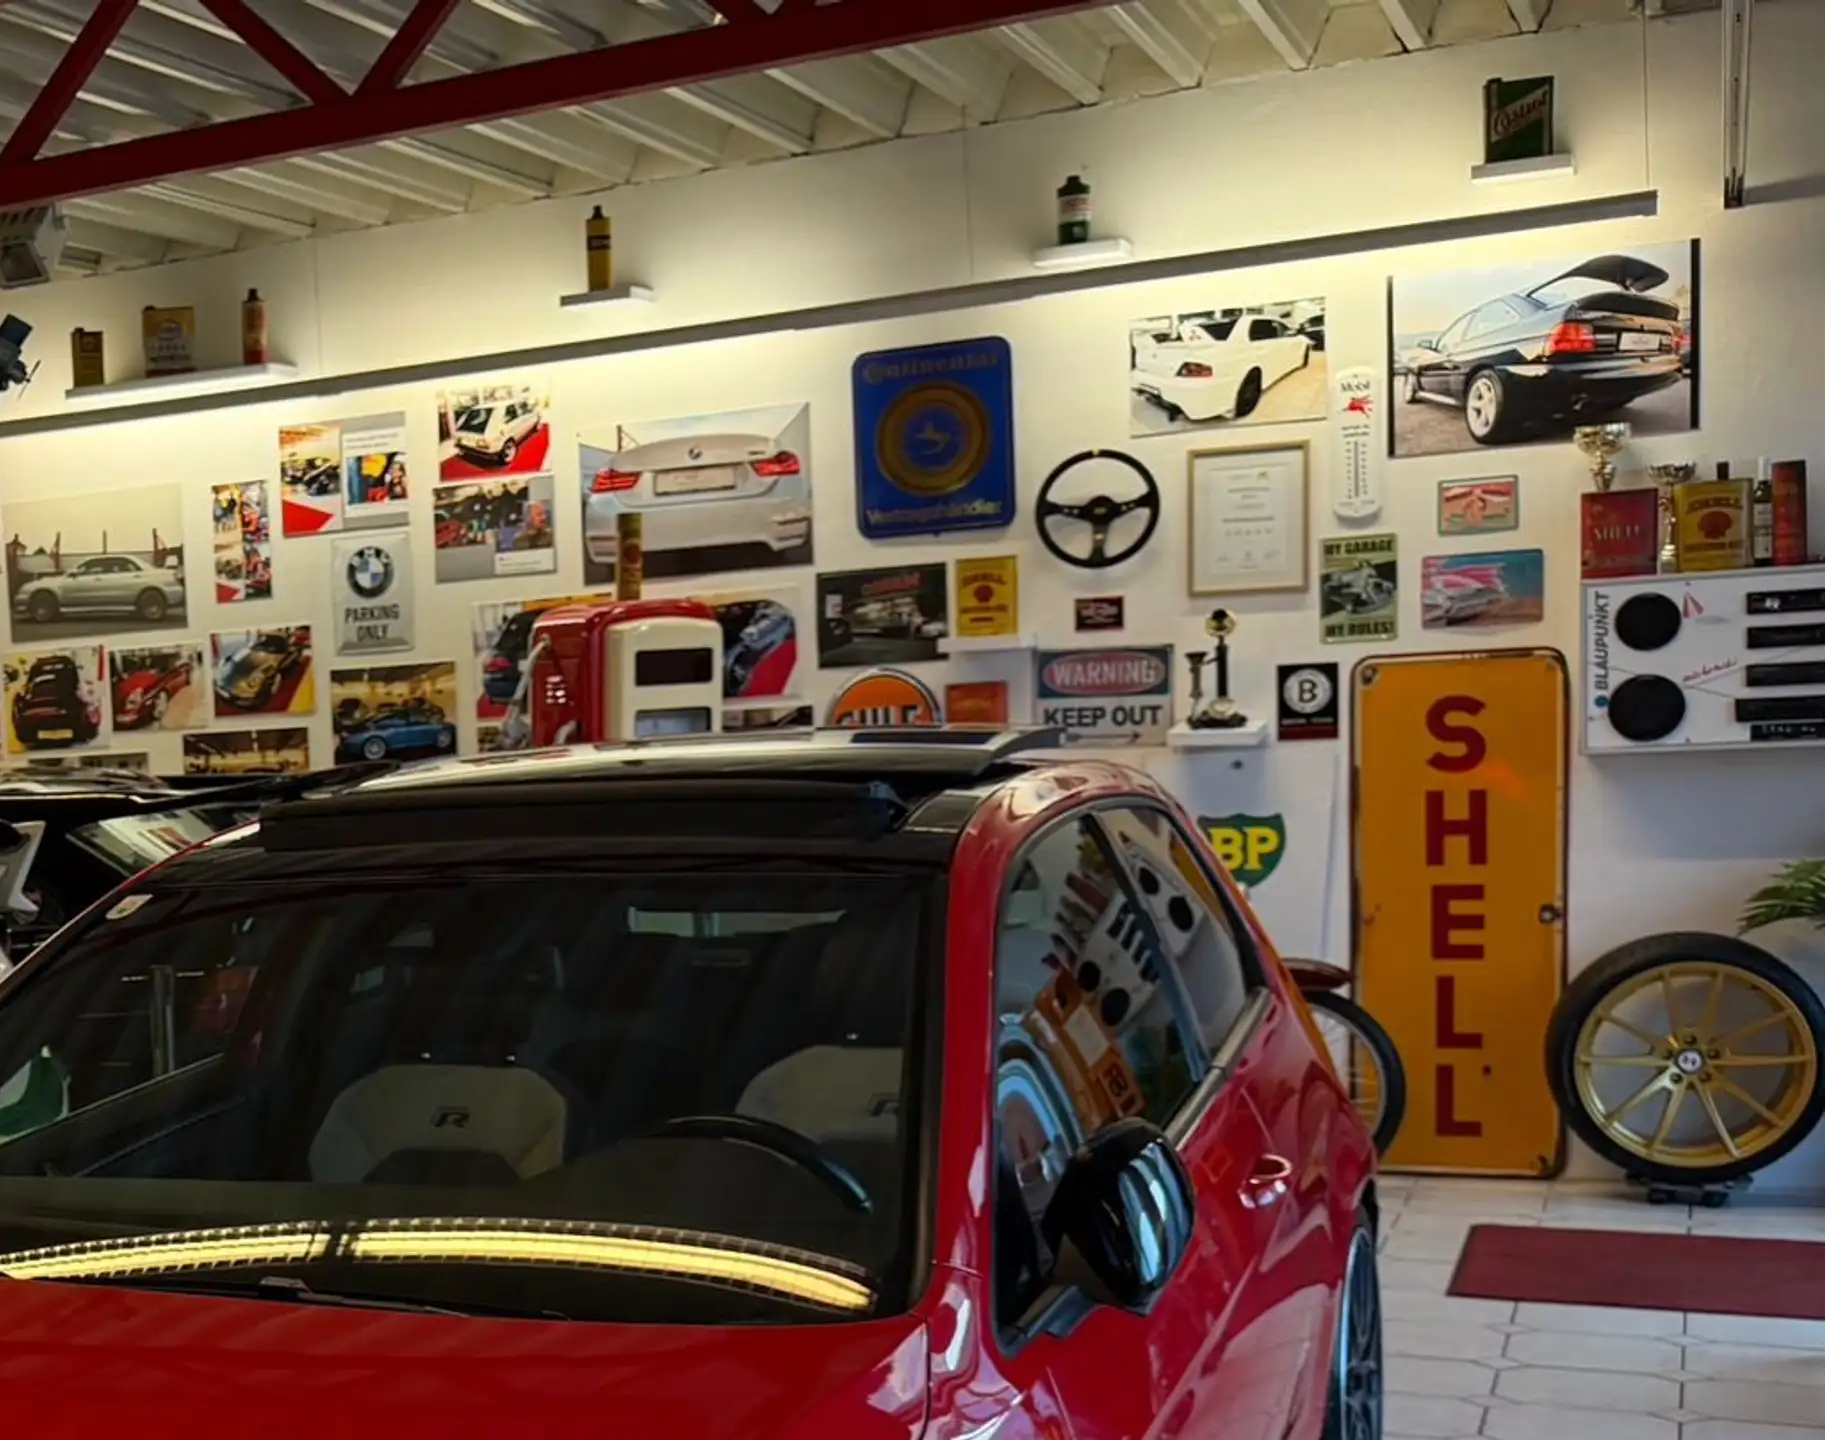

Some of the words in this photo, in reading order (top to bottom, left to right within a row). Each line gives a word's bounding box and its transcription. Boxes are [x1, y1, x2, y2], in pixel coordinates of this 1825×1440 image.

[344, 603, 400, 625] PARKING
[356, 623, 390, 643] ONLY
[1594, 591, 1610, 691] BLAUPUNKT
[1052, 660, 1158, 685] WARNING
[1043, 707, 1105, 728] KEEP
[1111, 705, 1163, 726] OUT
[1207, 826, 1280, 871] BP
[1424, 693, 1489, 1139] SHELL
